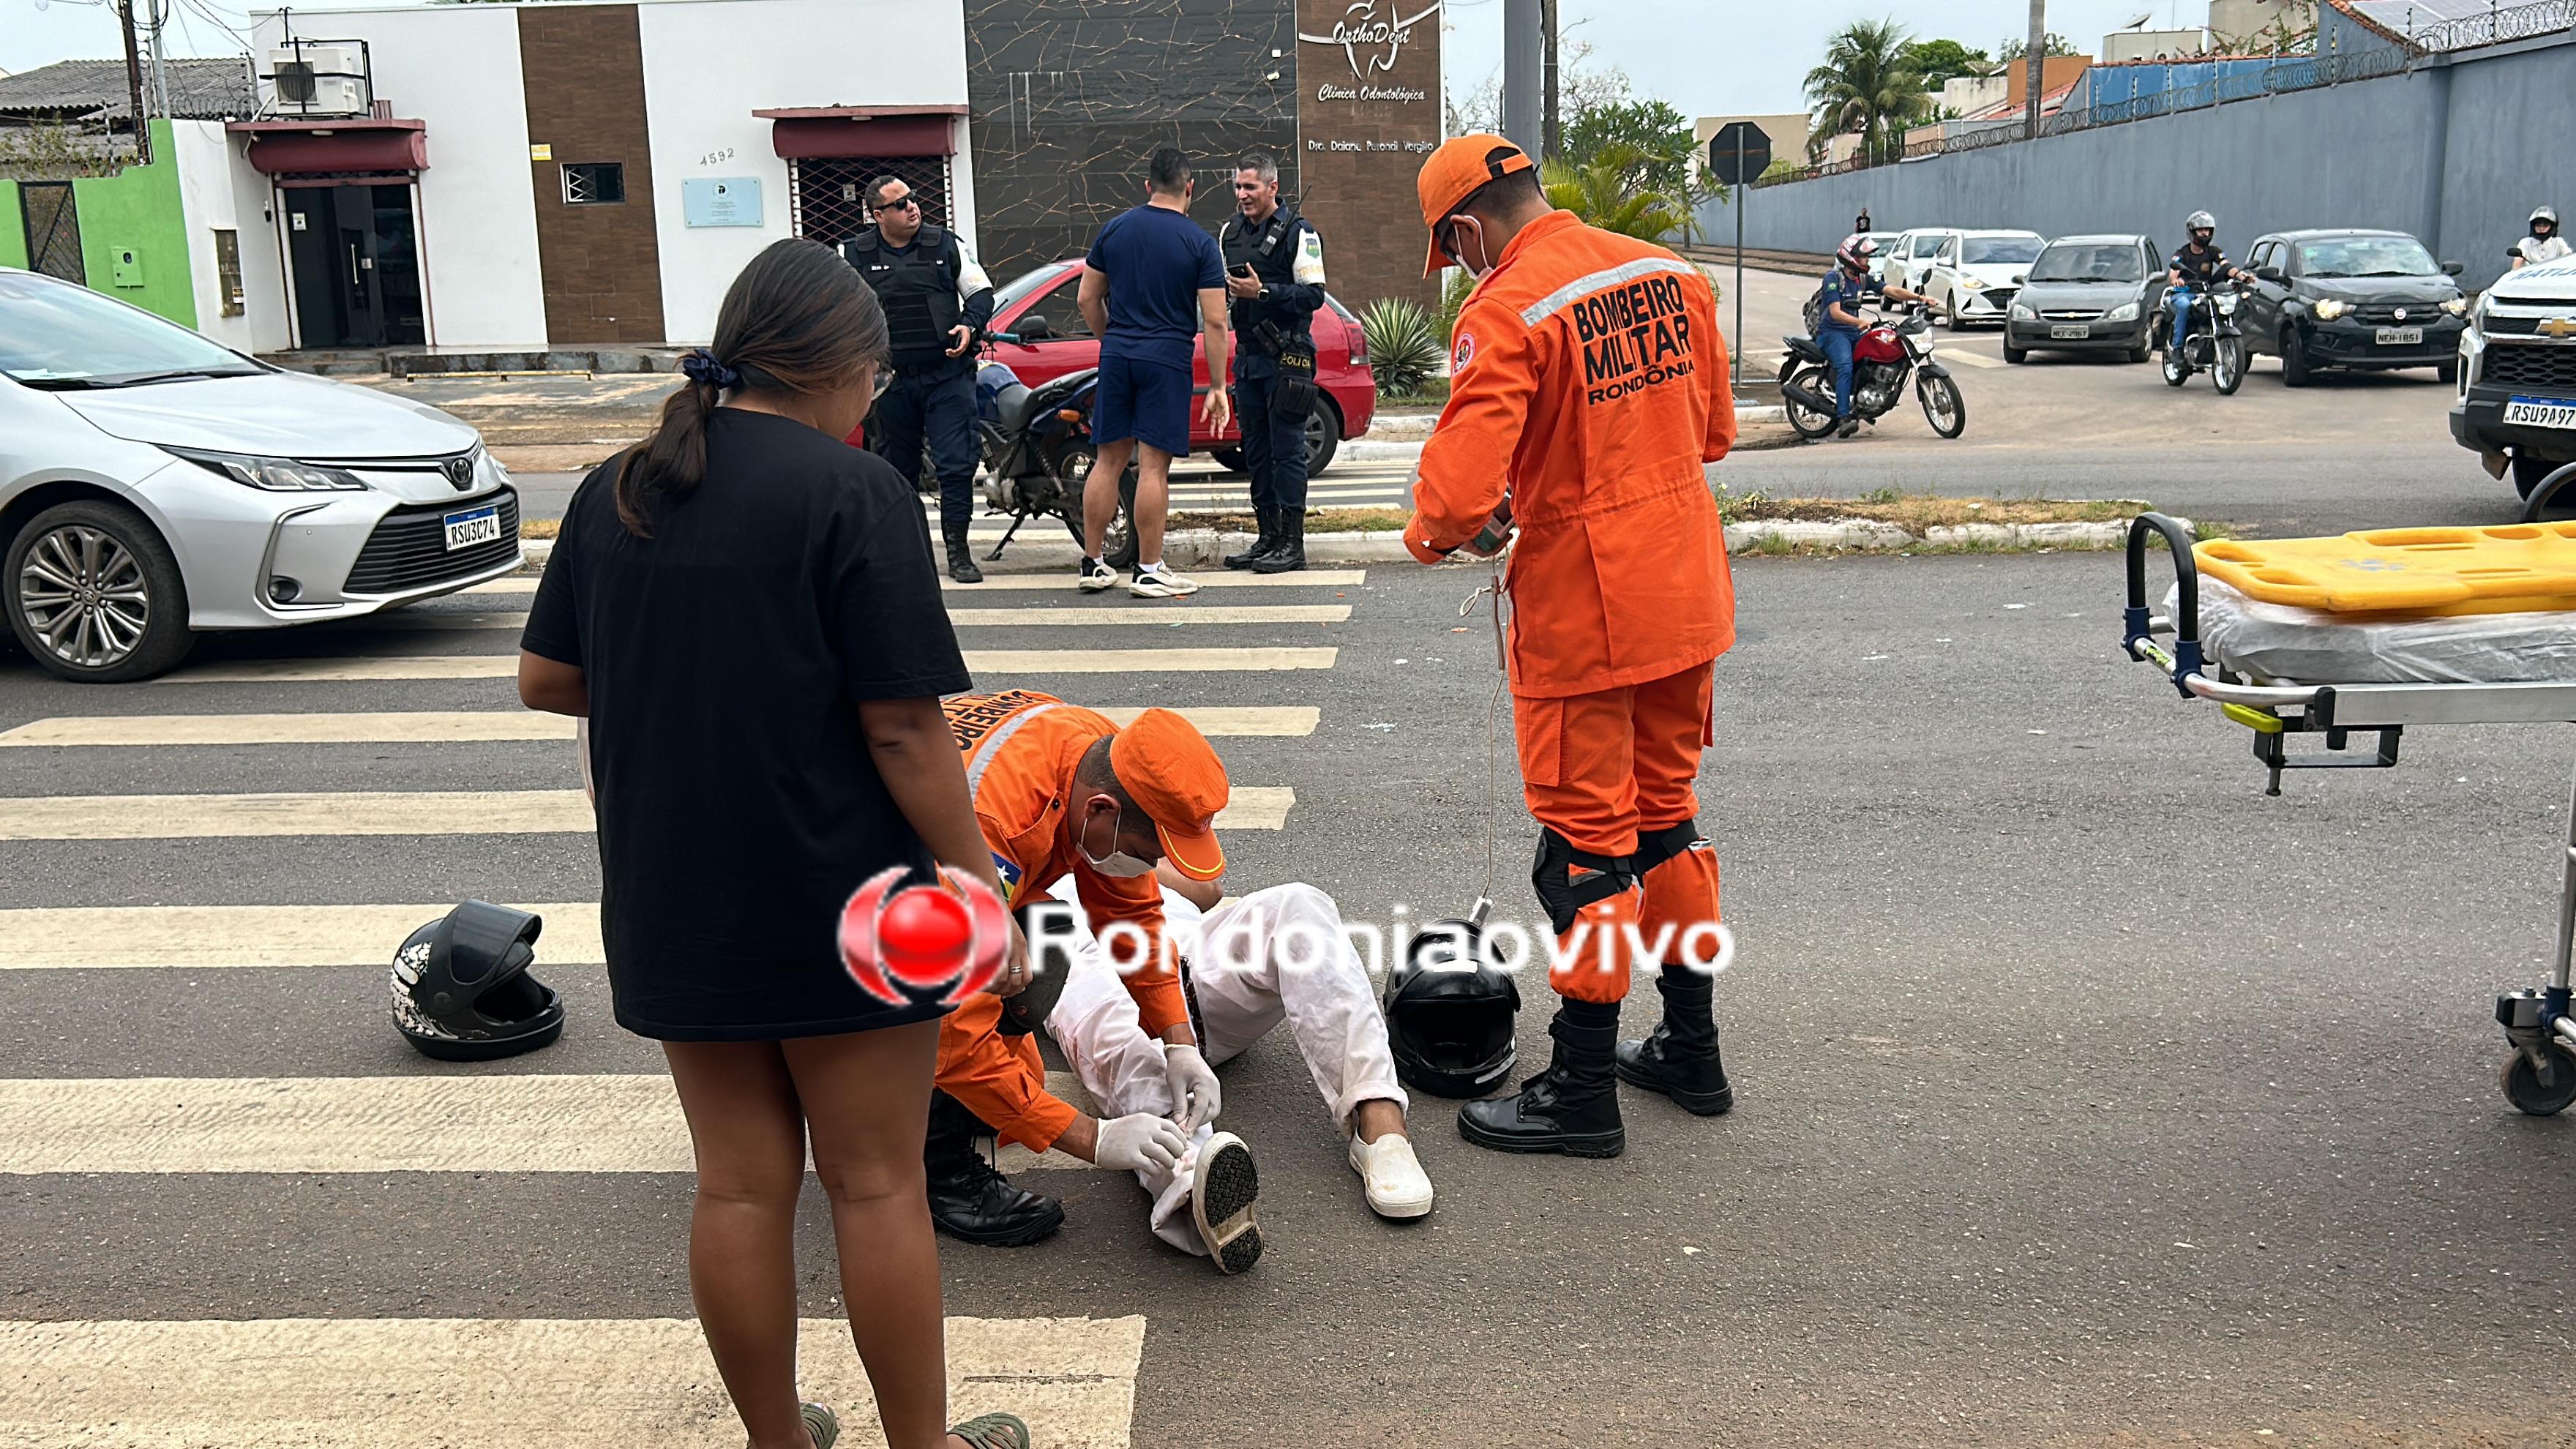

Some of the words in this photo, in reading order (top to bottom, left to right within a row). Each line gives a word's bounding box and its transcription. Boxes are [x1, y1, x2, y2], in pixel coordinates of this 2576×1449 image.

[1333, 20, 1411, 45] OrthoDent
[1318, 83, 1356, 102] Clínica
[1360, 86, 1426, 105] Odontológica
[700, 148, 735, 166] 4592
[1308, 140, 1325, 151] Dra.
[1330, 140, 1361, 151] Daiane
[1573, 275, 1685, 342] BOMBEIRO
[1583, 314, 1693, 385] MILITAR
[1588, 359, 1696, 405] RONDÔNIA
[2511, 405, 2576, 425] RSU9A97
[451, 517, 495, 547] RSU3C74
